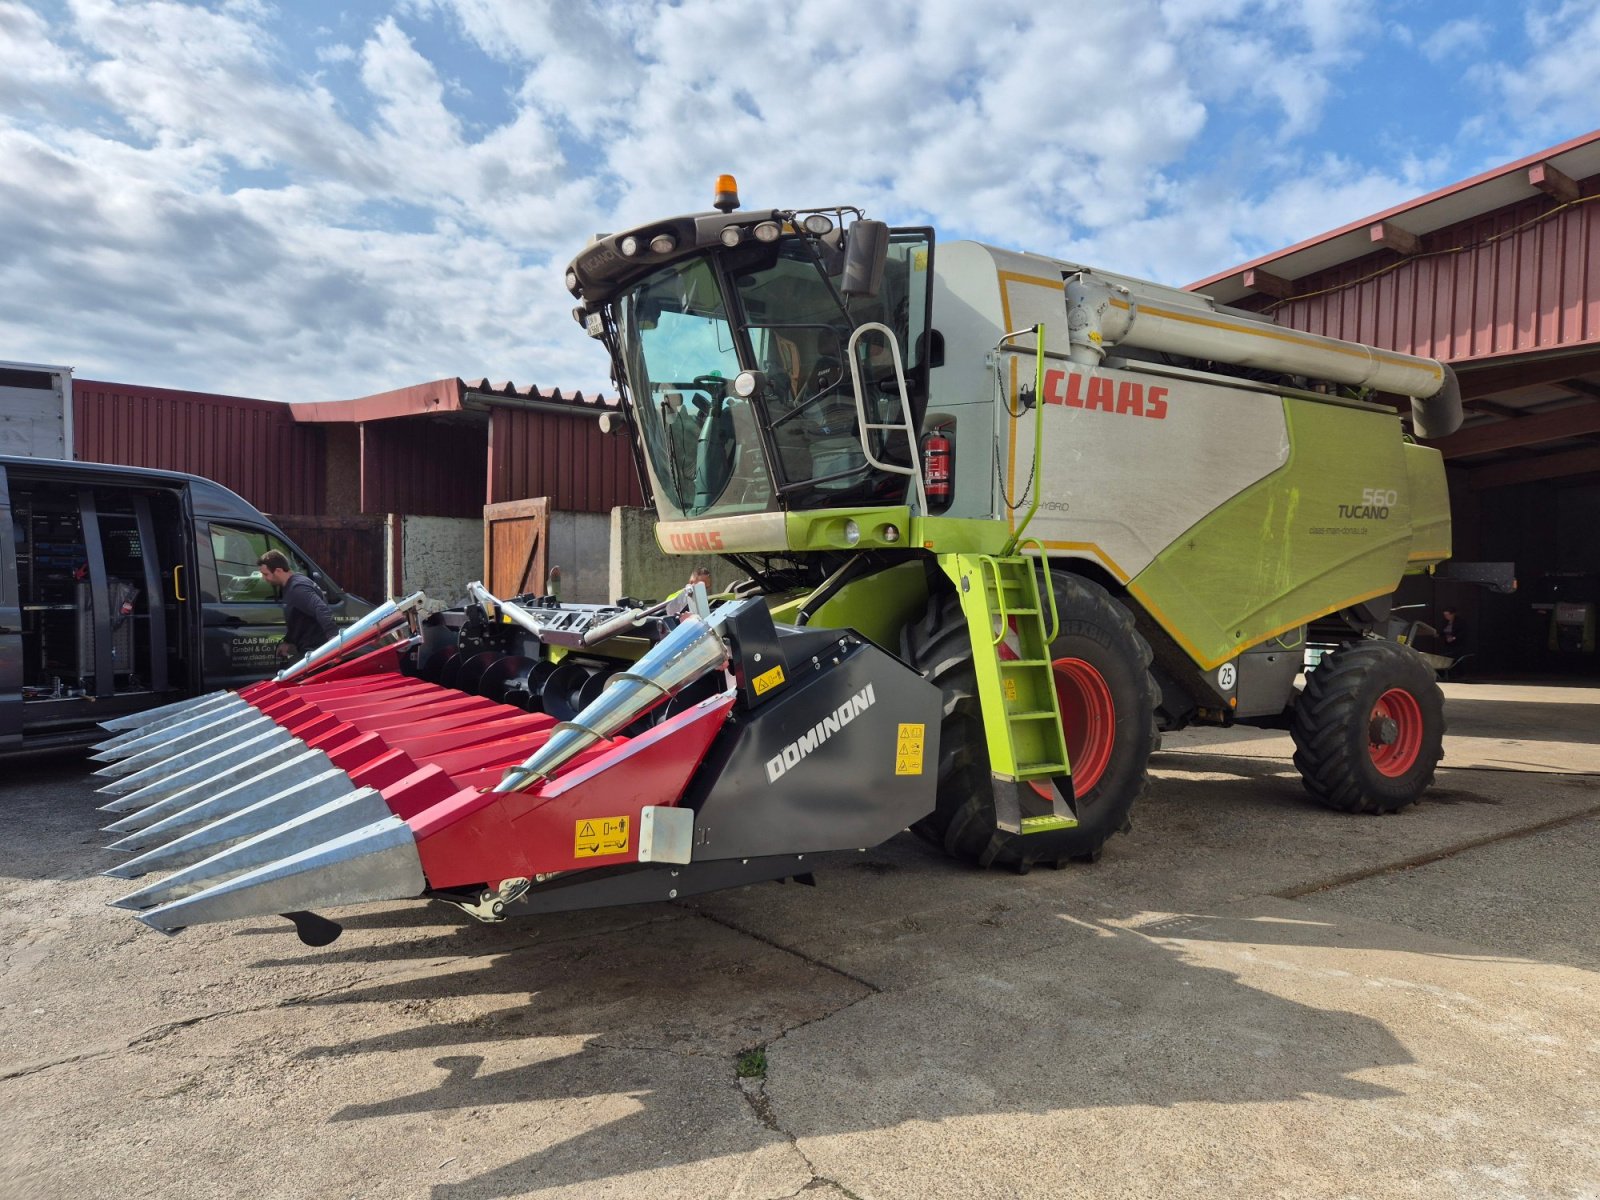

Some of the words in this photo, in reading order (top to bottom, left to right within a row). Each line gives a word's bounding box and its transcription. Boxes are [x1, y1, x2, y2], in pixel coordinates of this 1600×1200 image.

[1043, 369, 1169, 419] CLAAS
[1362, 487, 1398, 507] 560
[1338, 505, 1389, 519] TUCANO
[670, 531, 724, 551] CLAAS
[232, 637, 258, 645] CLAAS
[1221, 667, 1232, 685] 25
[765, 682, 876, 784] DOMINONI
